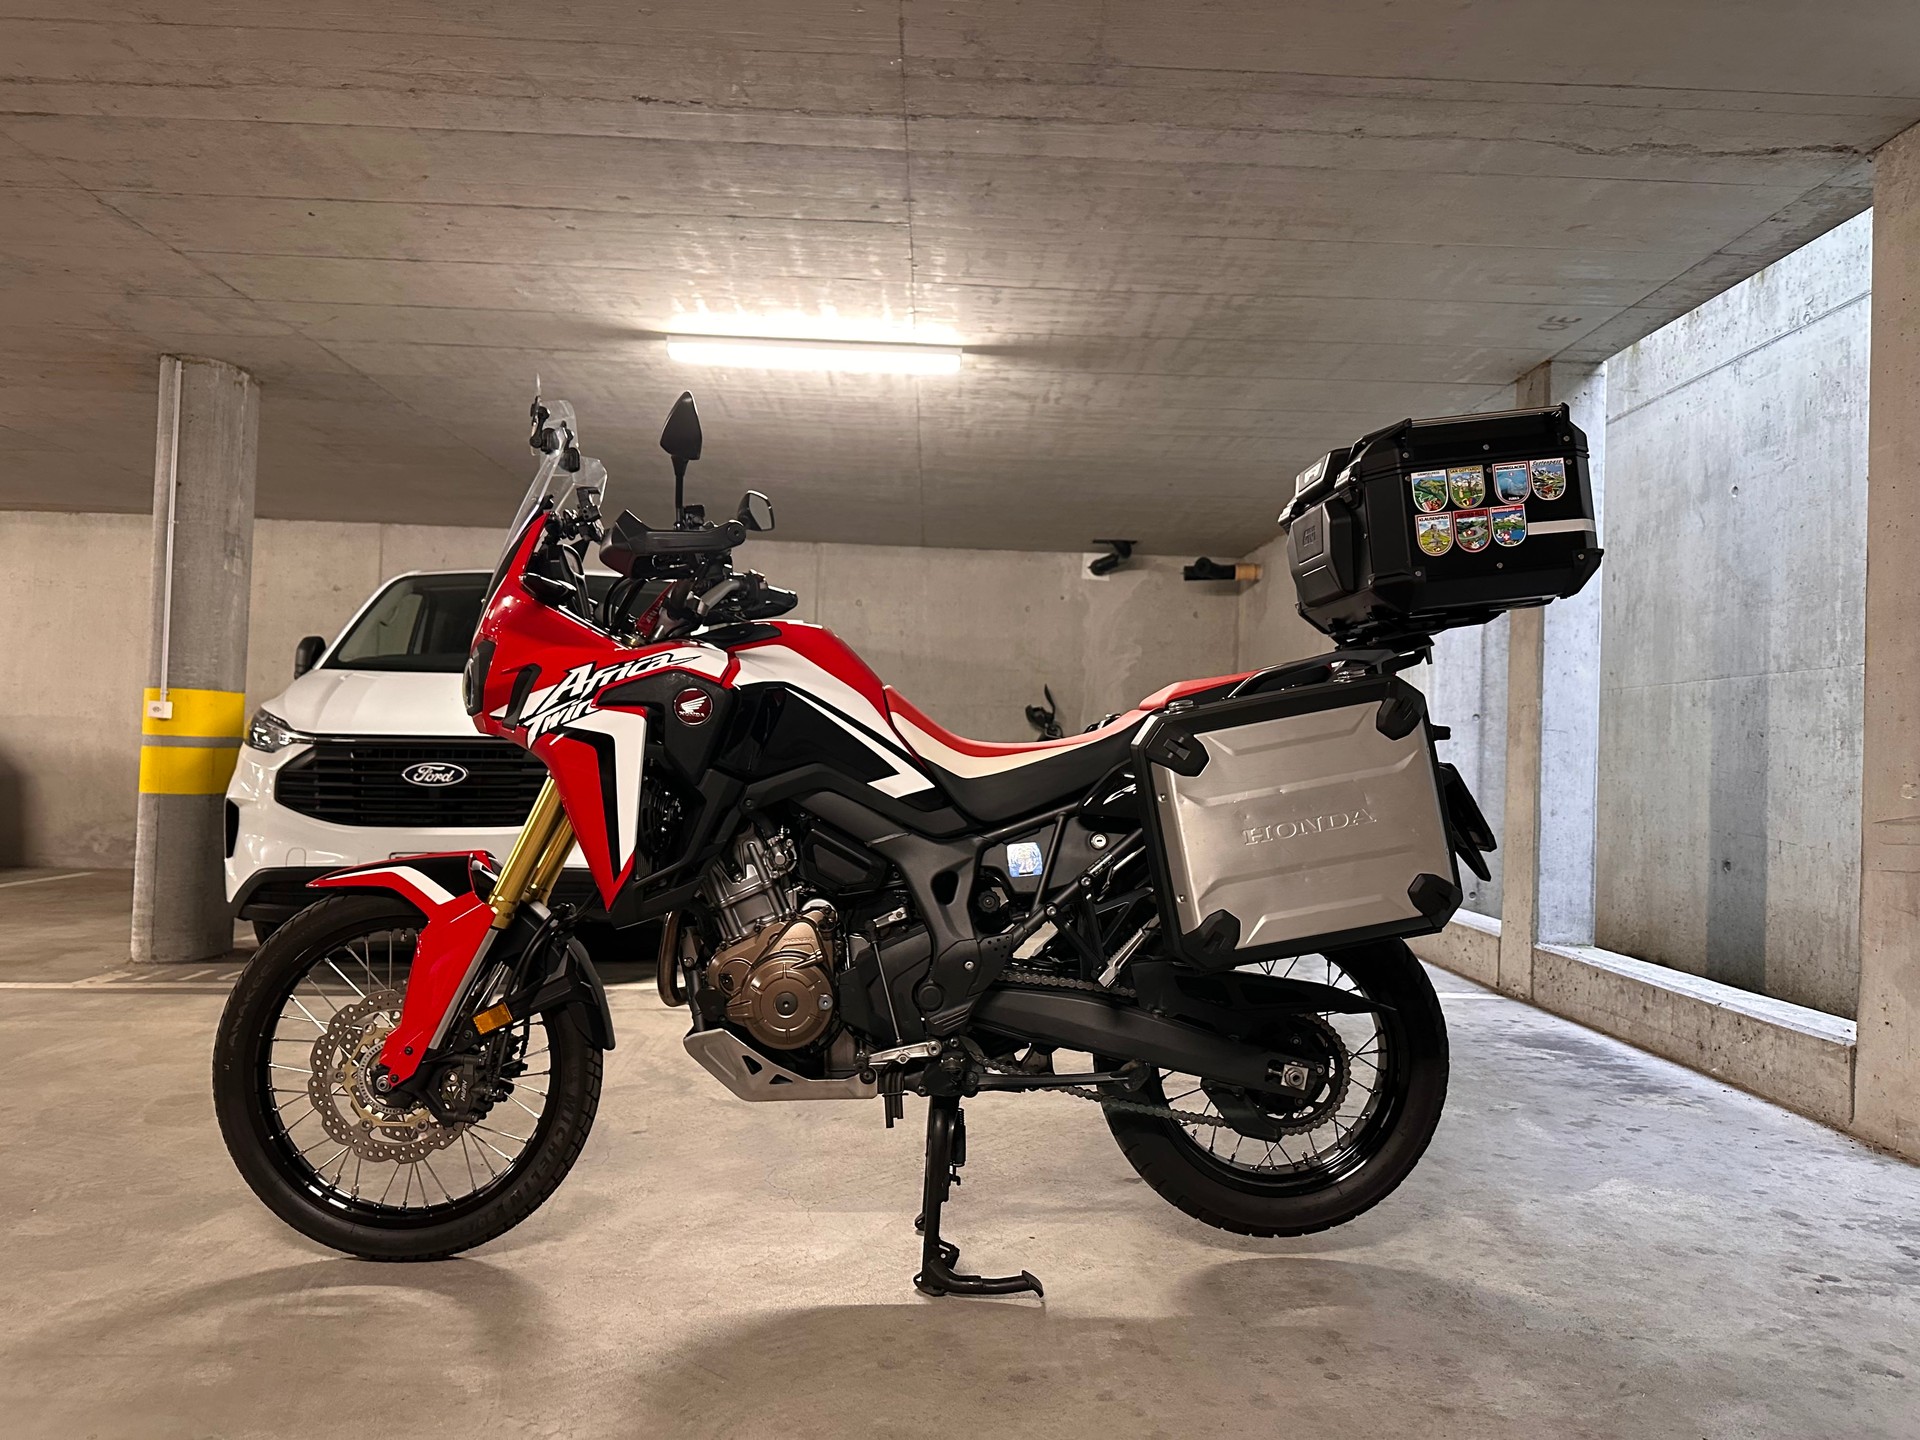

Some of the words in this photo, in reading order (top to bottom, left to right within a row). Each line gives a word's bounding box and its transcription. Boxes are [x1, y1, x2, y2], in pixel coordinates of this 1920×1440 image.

[534, 652, 702, 716] Africa
[524, 698, 601, 750] Twin
[413, 765, 455, 782] Ford
[1242, 808, 1377, 846] HONDA
[509, 1092, 577, 1204] MICHELIN
